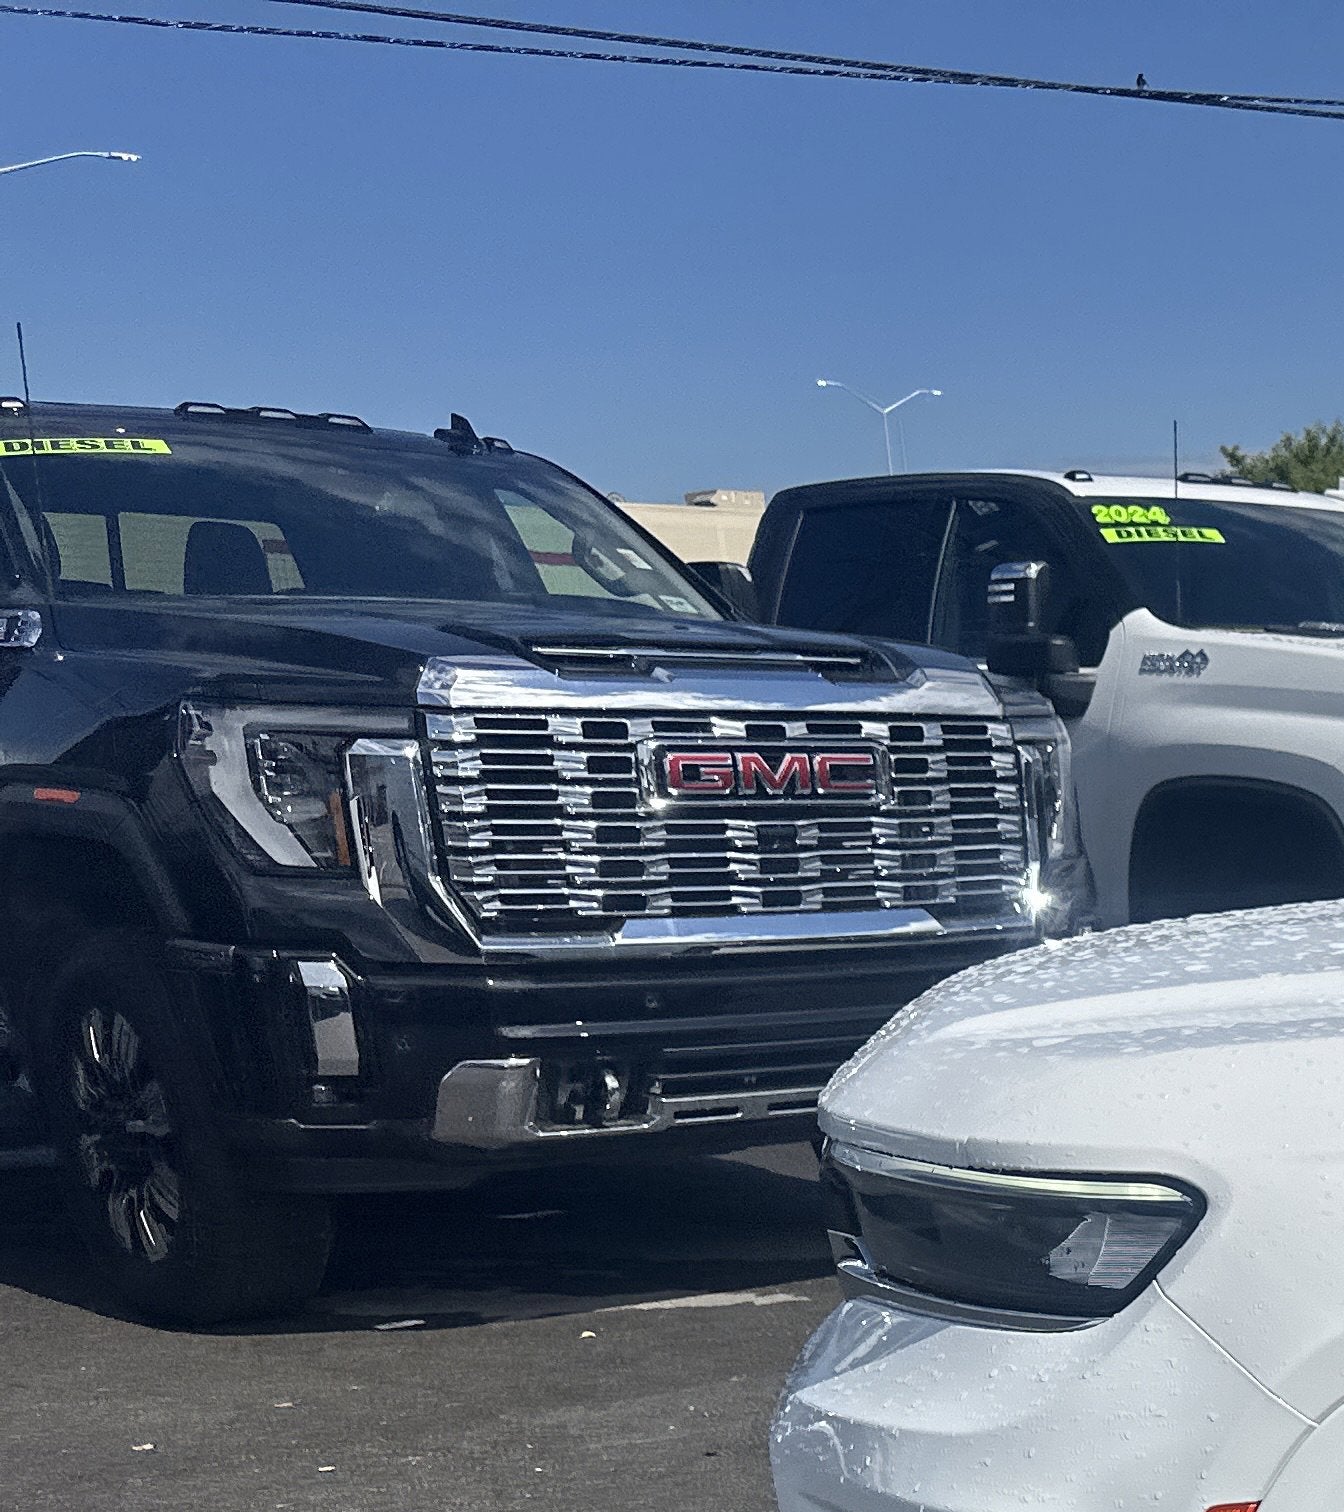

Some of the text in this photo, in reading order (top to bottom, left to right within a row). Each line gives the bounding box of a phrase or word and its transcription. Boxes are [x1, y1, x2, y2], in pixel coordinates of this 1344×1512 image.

[2, 438, 157, 453] DIESEL
[1091, 504, 1171, 525] 2024
[1114, 527, 1216, 540] DIESEL
[664, 752, 878, 796] GMC
